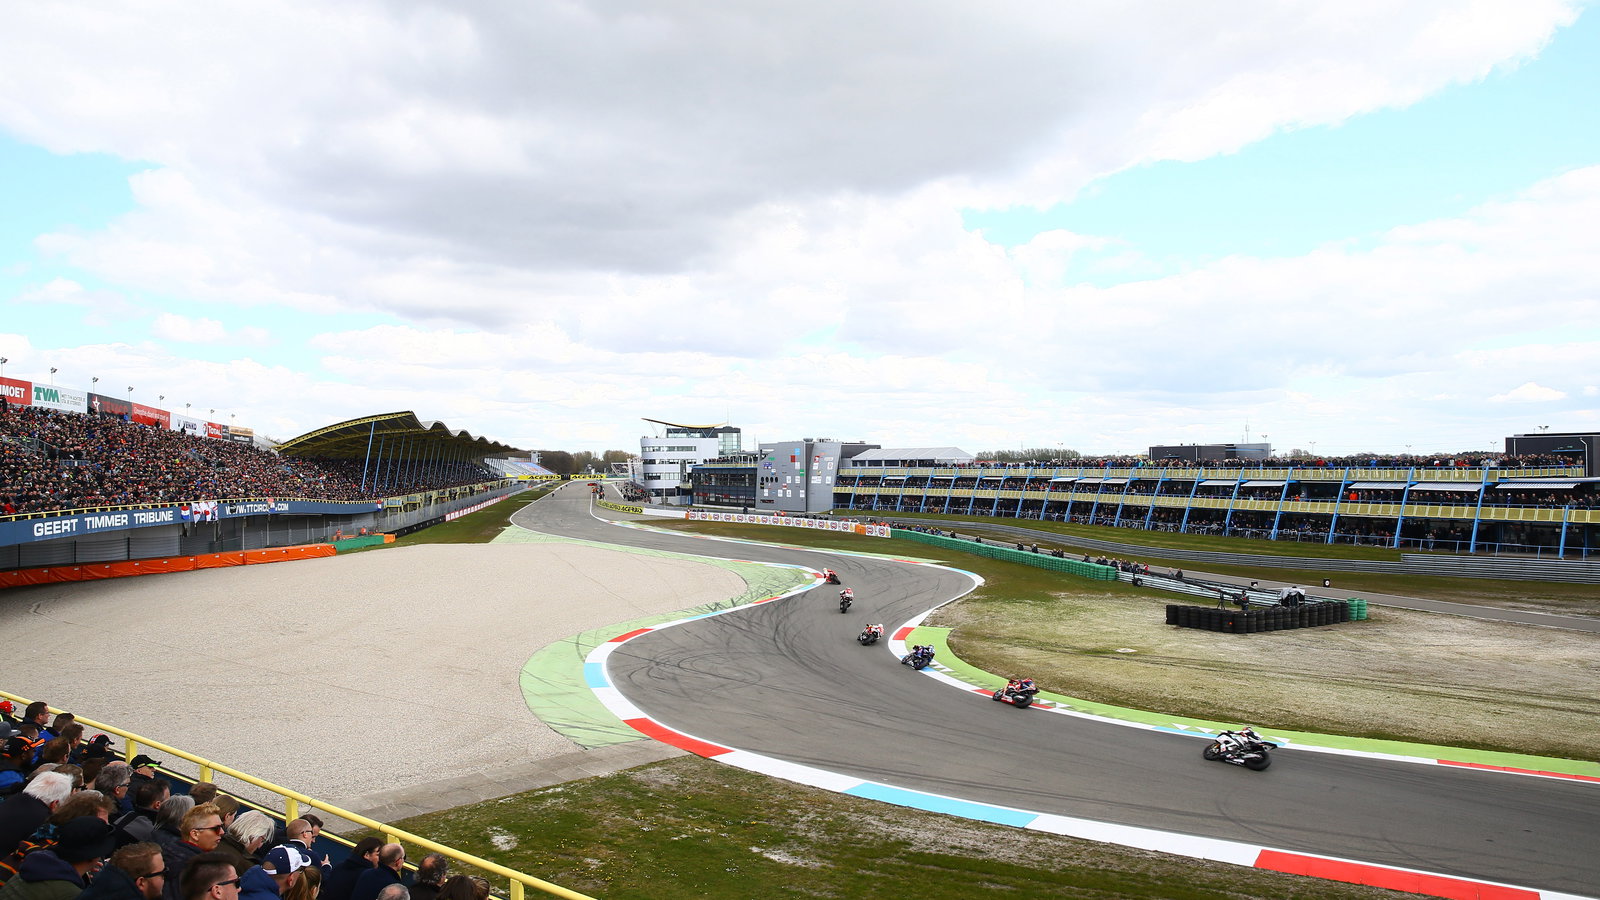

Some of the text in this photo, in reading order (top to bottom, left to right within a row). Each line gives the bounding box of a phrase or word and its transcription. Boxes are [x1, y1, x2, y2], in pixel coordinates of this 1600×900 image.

[34, 386, 60, 403] TVM
[34, 510, 174, 537] GEERT TIMMER TRIBUNE
